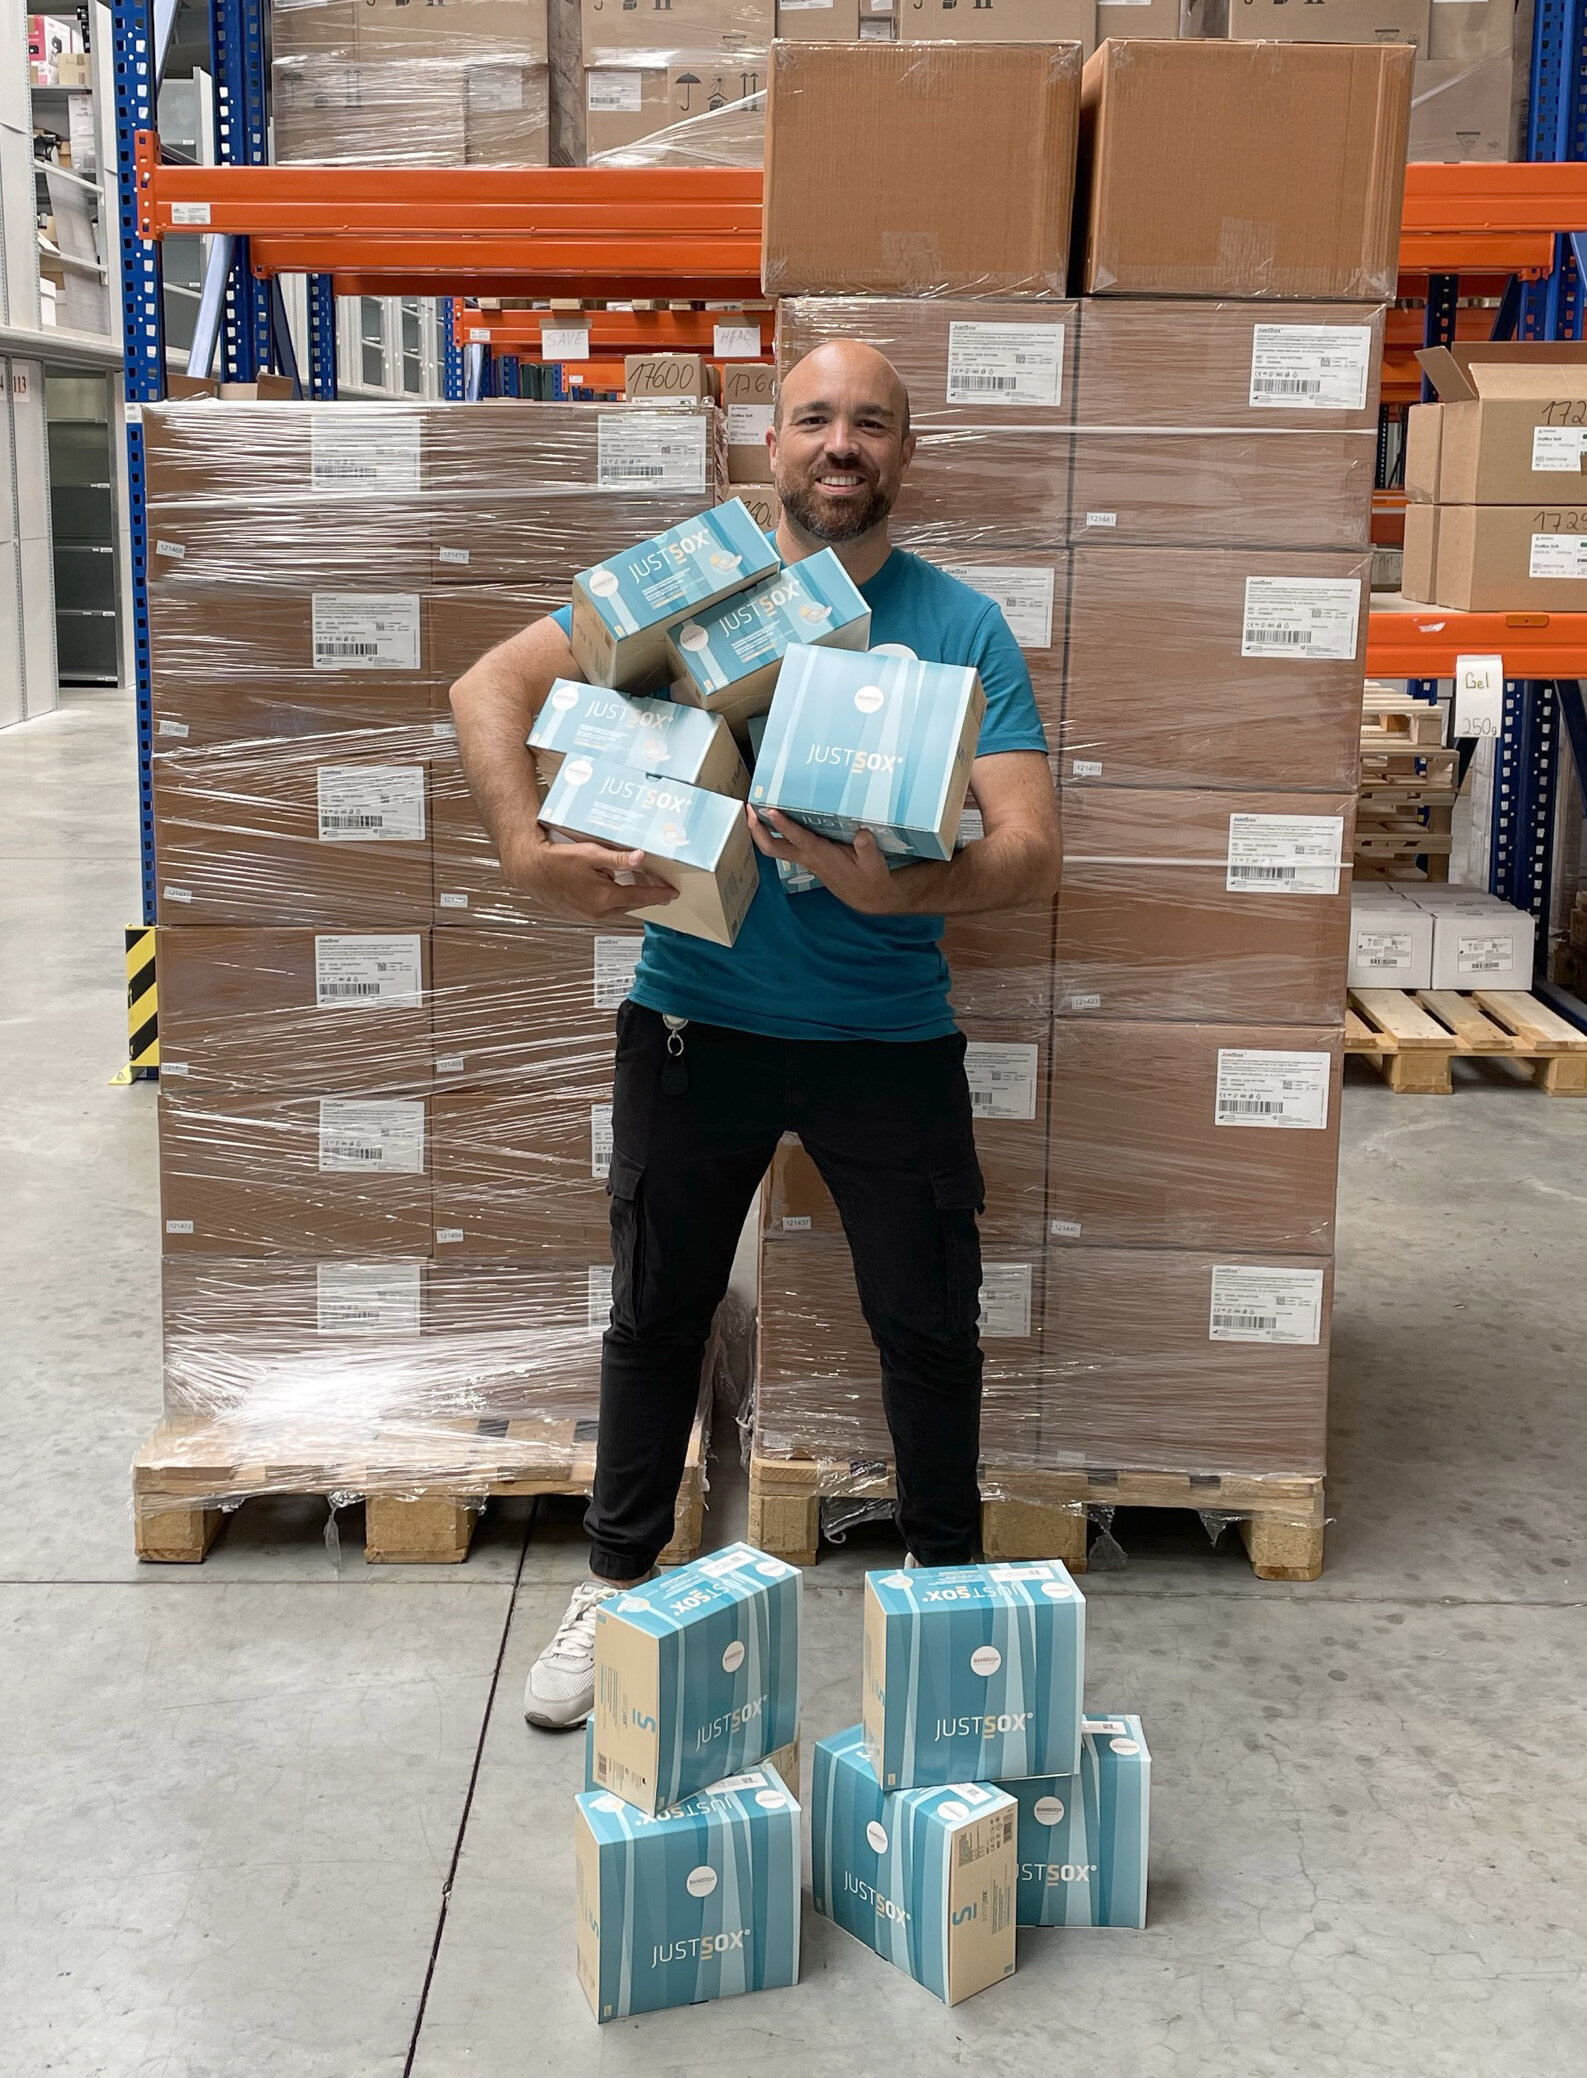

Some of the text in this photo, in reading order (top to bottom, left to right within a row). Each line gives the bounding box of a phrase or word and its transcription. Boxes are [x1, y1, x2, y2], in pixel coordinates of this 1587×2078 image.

[547, 331, 585, 347] SAVE
[628, 361, 694, 394] 17600
[1465, 672, 1489, 689] Gel
[1462, 717, 1497, 737] 250g
[806, 744, 899, 774] JUSTSOX
[696, 1697, 765, 1752] JUSTSOX
[935, 1713, 1030, 1742] JUSTSOX
[844, 1870, 909, 1928] JUSTSOX
[651, 1931, 747, 1969] JUSTSOX
